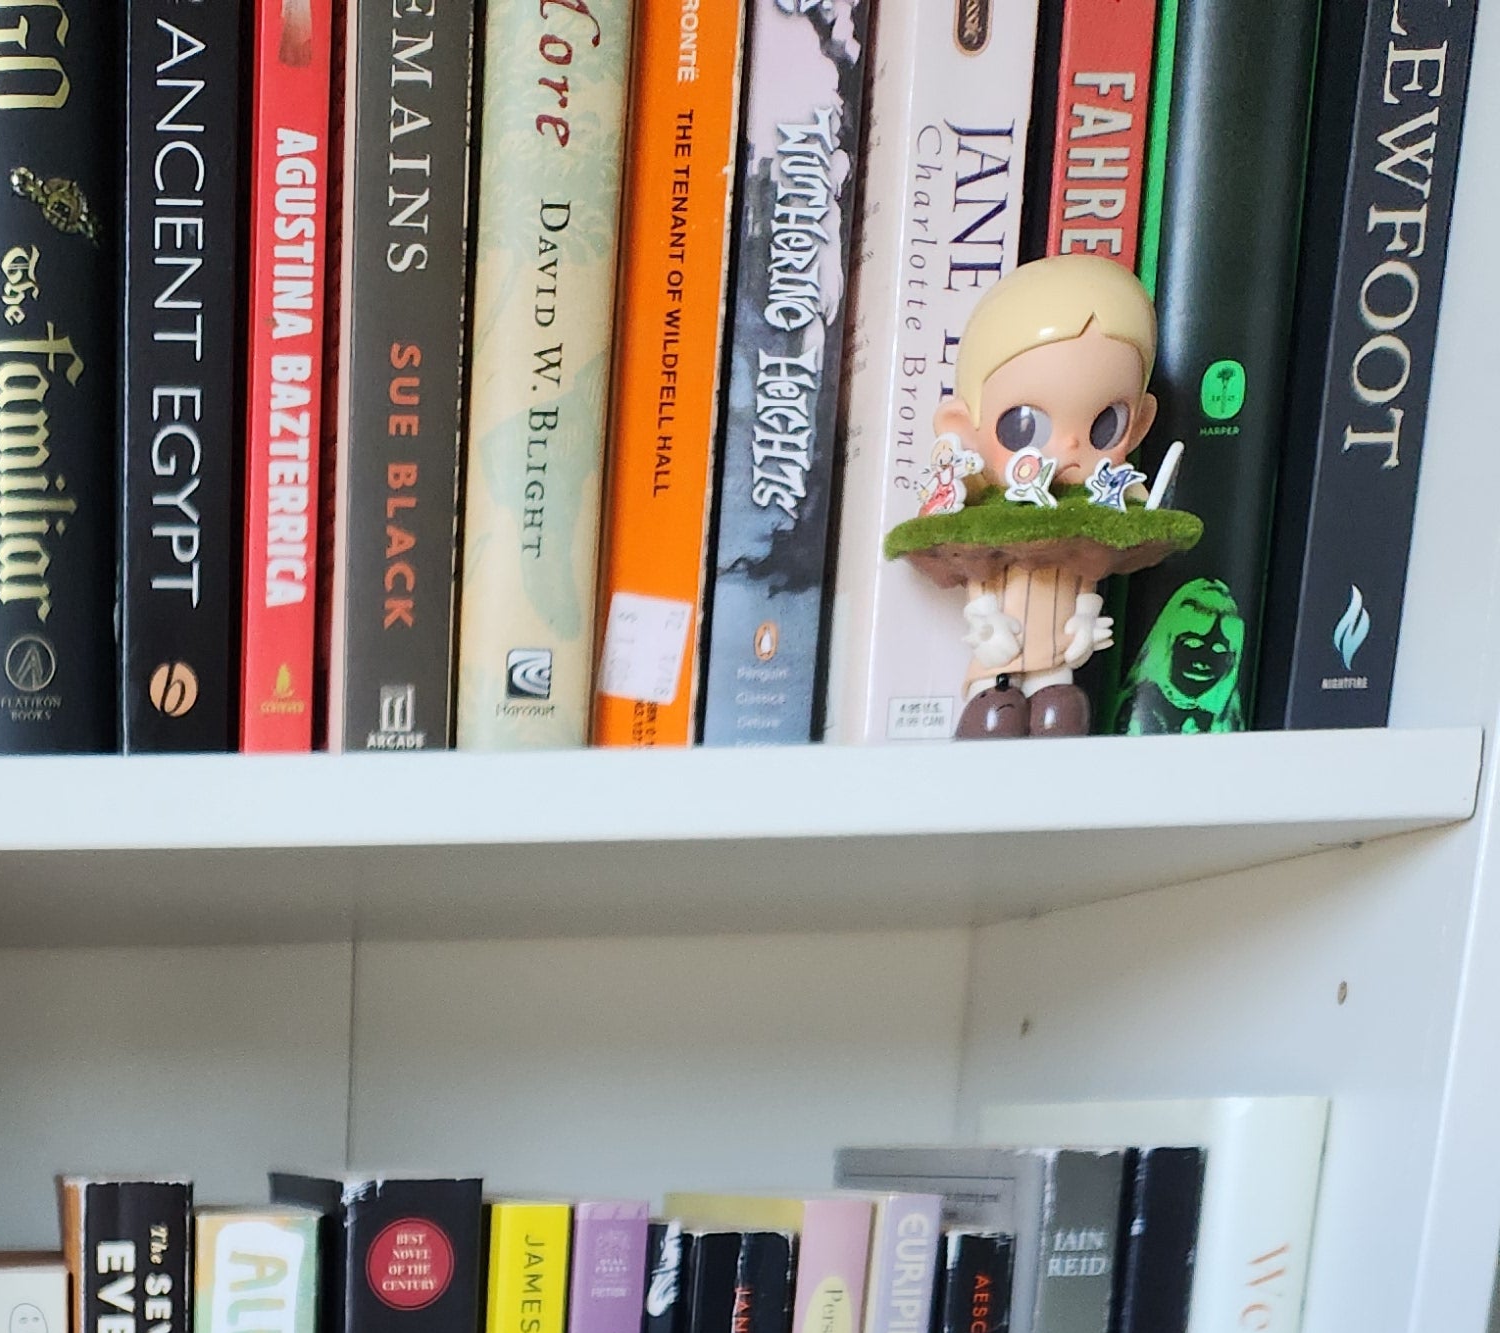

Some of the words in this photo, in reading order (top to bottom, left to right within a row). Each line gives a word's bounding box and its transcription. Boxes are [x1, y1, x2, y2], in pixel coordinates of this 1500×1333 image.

[677, 109, 694, 157] THE
[153, 18, 207, 363] ANCIENT
[672, 161, 692, 265] TENANT
[903, 124, 943, 332] Charlotte
[942, 118, 1017, 292] JANE
[273, 126, 319, 342] AGUSTINA
[534, 199, 570, 329] DAVID
[0, 245, 41, 326] The
[668, 270, 685, 302] OF
[387, 340, 424, 438] SUE
[530, 342, 563, 394] W.
[658, 305, 683, 426] WILDFELL
[892, 340, 927, 491] Brontë
[1200, 425, 1241, 438] HARPER
[148, 386, 202, 611] EGYPT
[263, 354, 313, 610] BAZTERRICA
[518, 406, 560, 560] BLIGHT
[652, 429, 675, 499] HALL
[382, 464, 419, 631] BLACK
[10, 710, 53, 722] BOOKS
[366, 733, 427, 749] ARCADE
[148, 1222, 171, 1266] The
[388, 1263, 405, 1276] OF
[407, 1263, 432, 1276] THE
[392, 1248, 433, 1261] NOVEL
[396, 1233, 425, 1247] BEST
[1046, 1256, 1107, 1278] REID
[1052, 1227, 1109, 1252] IAIN
[382, 1278, 438, 1292] CENTURY
